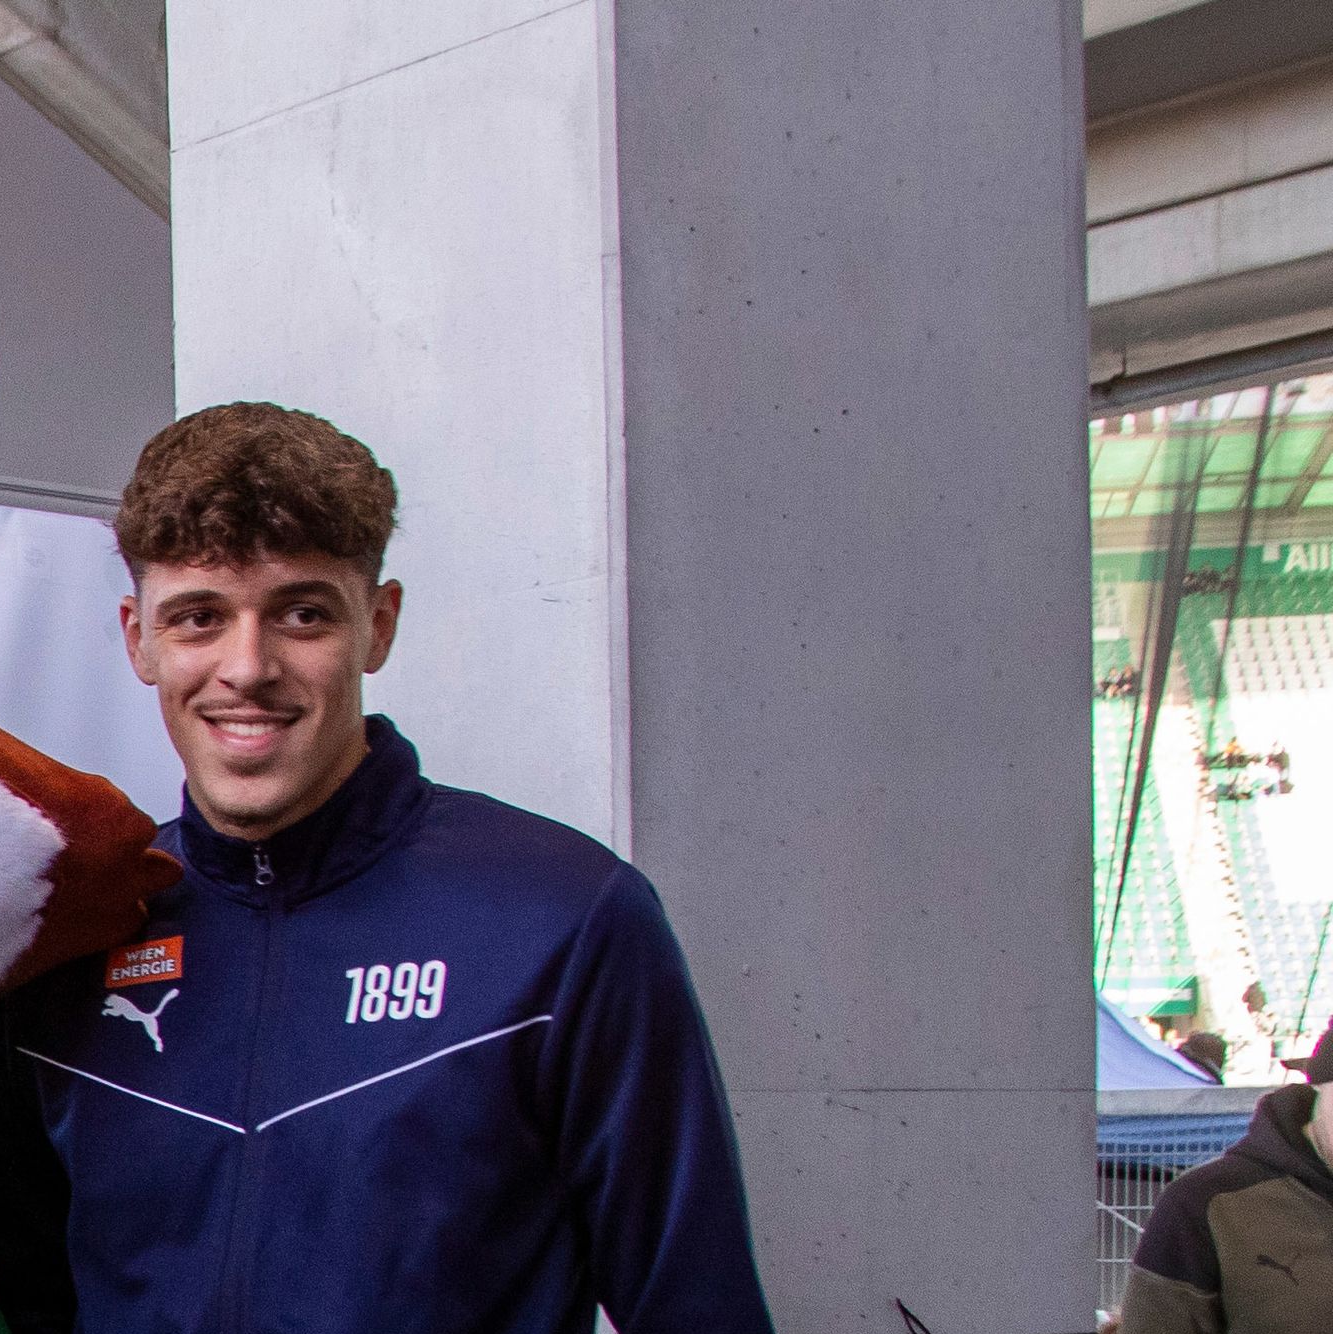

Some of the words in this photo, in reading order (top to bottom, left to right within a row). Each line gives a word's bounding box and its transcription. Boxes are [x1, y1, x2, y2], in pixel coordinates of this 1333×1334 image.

[1283, 543, 1333, 572] All
[126, 945, 166, 962] WIEN
[112, 959, 176, 980] ENERGIE
[345, 959, 447, 1024] 1899
